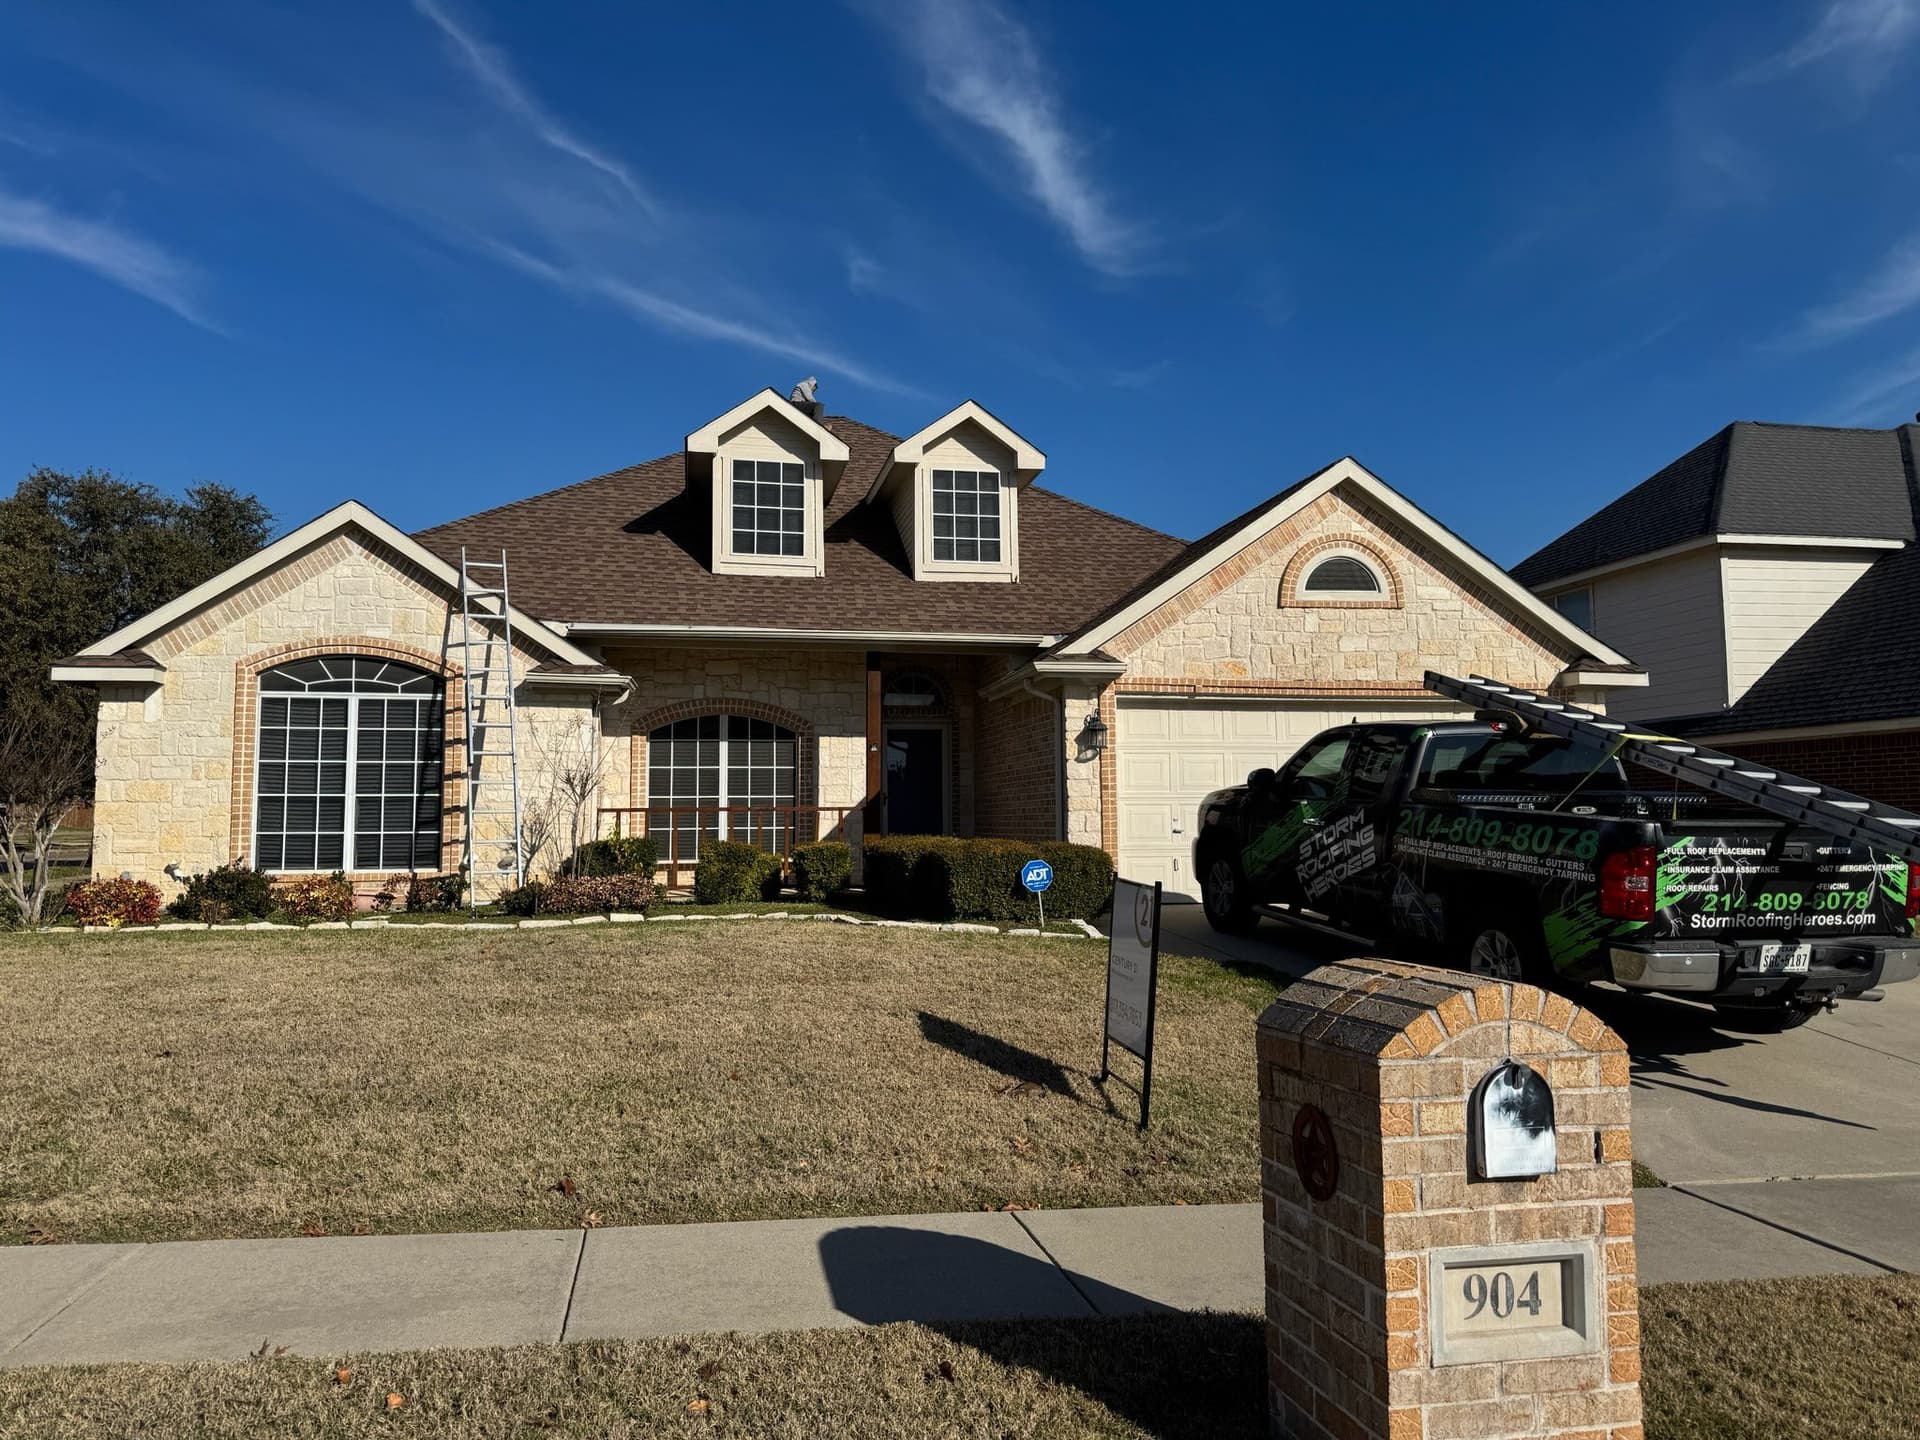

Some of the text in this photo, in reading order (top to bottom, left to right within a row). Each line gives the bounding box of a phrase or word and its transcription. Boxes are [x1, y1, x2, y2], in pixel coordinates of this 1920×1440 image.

[1300, 808, 1364, 860] STORM
[1395, 807, 1599, 859] 214-809-8078
[1296, 823, 1375, 884] ROOFING
[1433, 842, 1481, 856] REPLACEMENTS
[1488, 850, 1507, 860] ROOF
[1507, 852, 1538, 865] REPAIRS
[1546, 858, 1585, 871] GUTTERS
[1667, 847, 1766, 856] FULL ROOF REPLACEMENTS
[1026, 868, 1049, 882] ADT
[1304, 845, 1376, 903] HEROES
[1447, 852, 1486, 865] ASSISTANCE
[1507, 861, 1554, 876] EMERGENCY
[1556, 869, 1596, 882] TARPING
[1667, 865, 1781, 874] INSURANCE CLAIM ASSISTANCE
[1835, 864, 1876, 873] EMERGENCY
[1666, 884, 1719, 893] ROOF REPAIRS
[1819, 882, 1849, 891] FENCING
[1702, 891, 1869, 912] 214-809-8078
[1690, 912, 1876, 930] StormRoofingHeroes.com
[1463, 1270, 1542, 1320] 904
